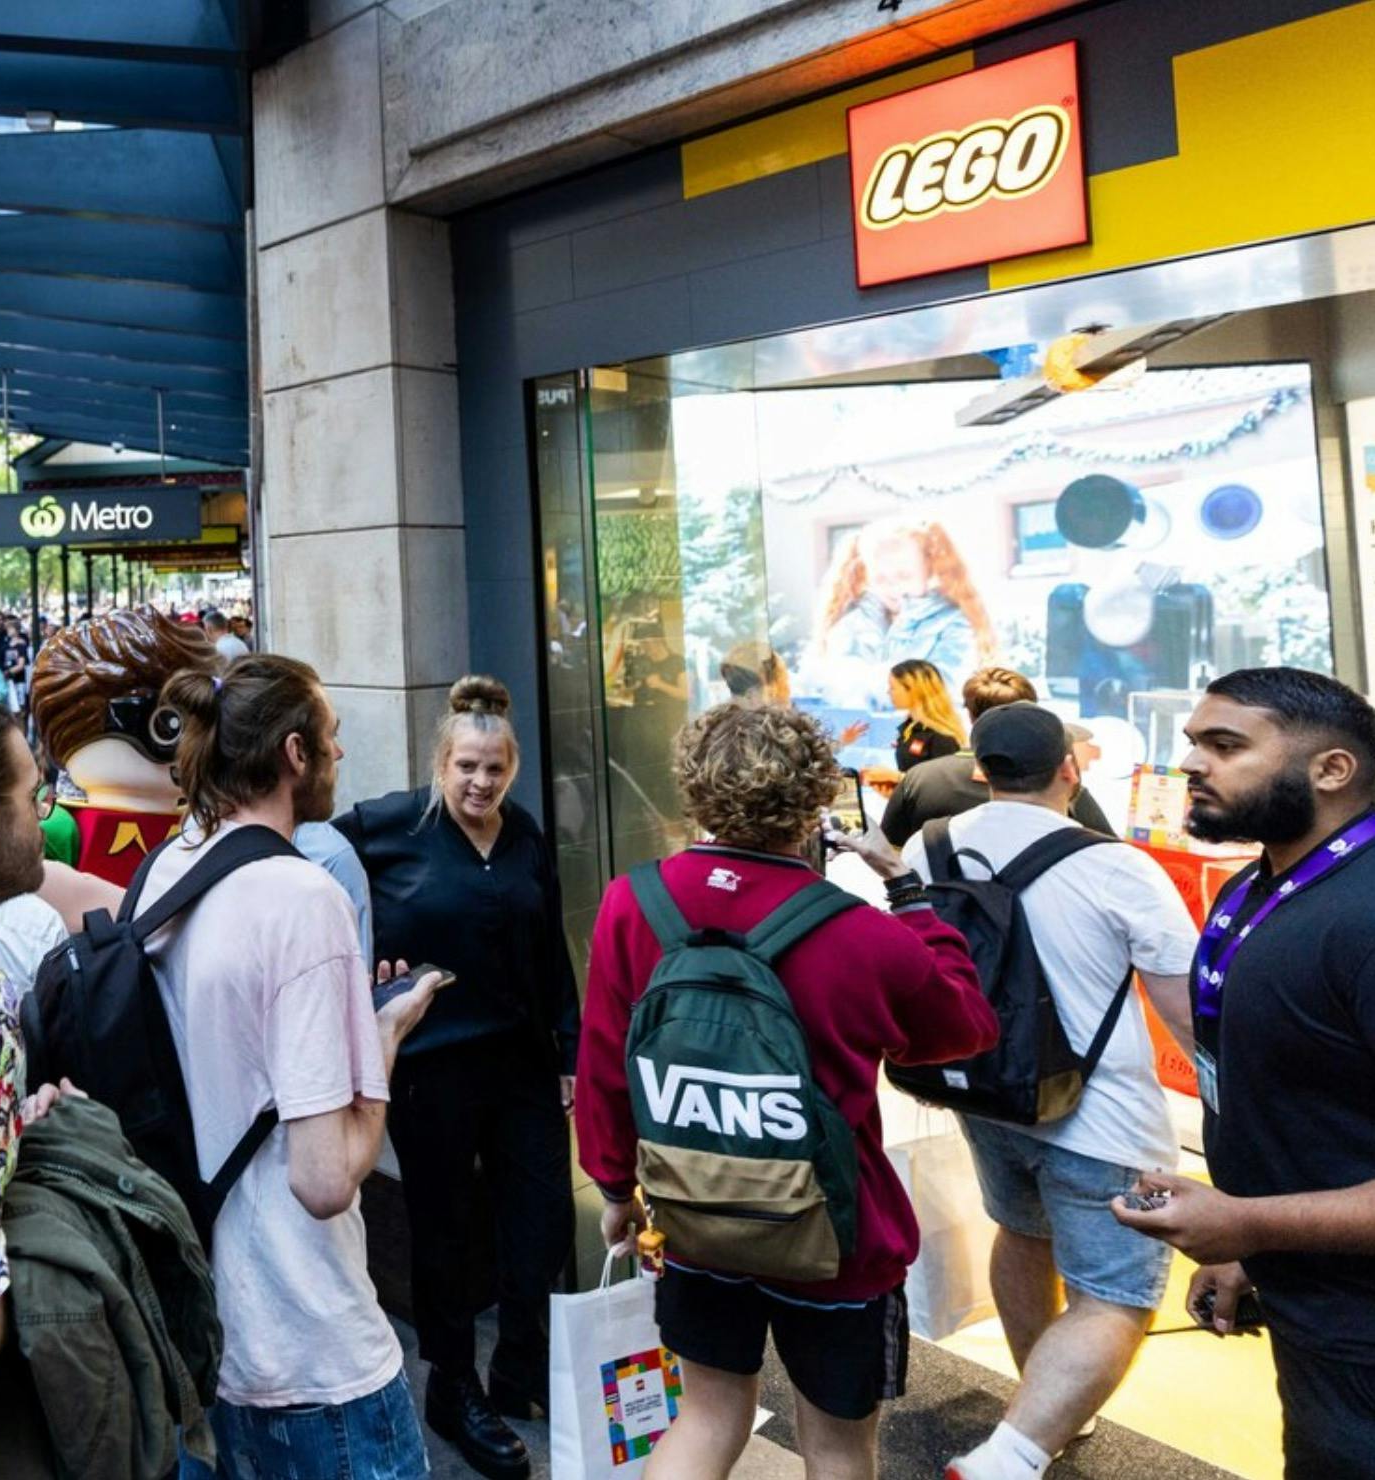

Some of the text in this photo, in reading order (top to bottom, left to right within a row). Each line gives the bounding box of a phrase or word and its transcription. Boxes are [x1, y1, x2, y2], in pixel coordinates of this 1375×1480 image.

[864, 109, 1065, 226] LEGO
[71, 501, 153, 531] Metro
[636, 1056, 808, 1140] VANS
